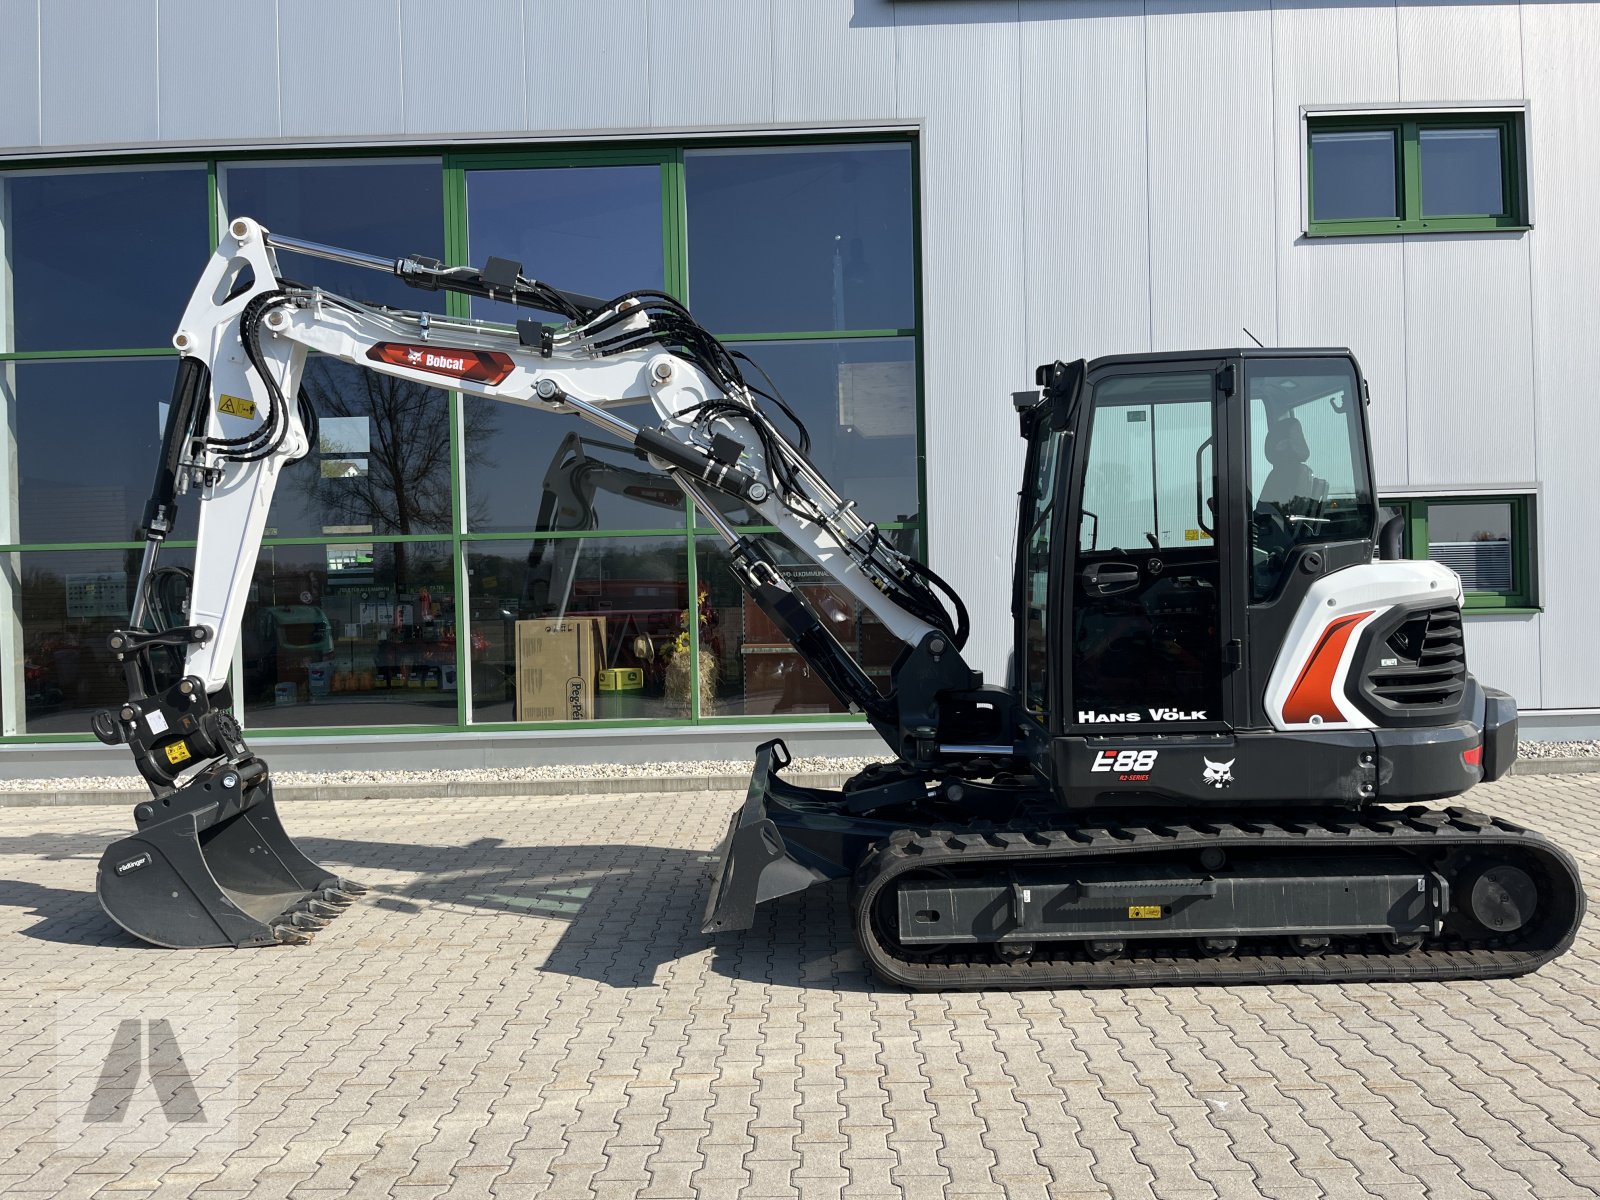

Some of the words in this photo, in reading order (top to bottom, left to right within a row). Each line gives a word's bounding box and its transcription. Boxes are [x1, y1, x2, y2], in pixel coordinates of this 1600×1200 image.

[426, 354, 464, 371] Bobcat
[1078, 711, 1141, 723] HANS
[1149, 707, 1207, 721] VÖLK
[1090, 750, 1158, 772] E88
[1119, 774, 1150, 782] R2-SERIES
